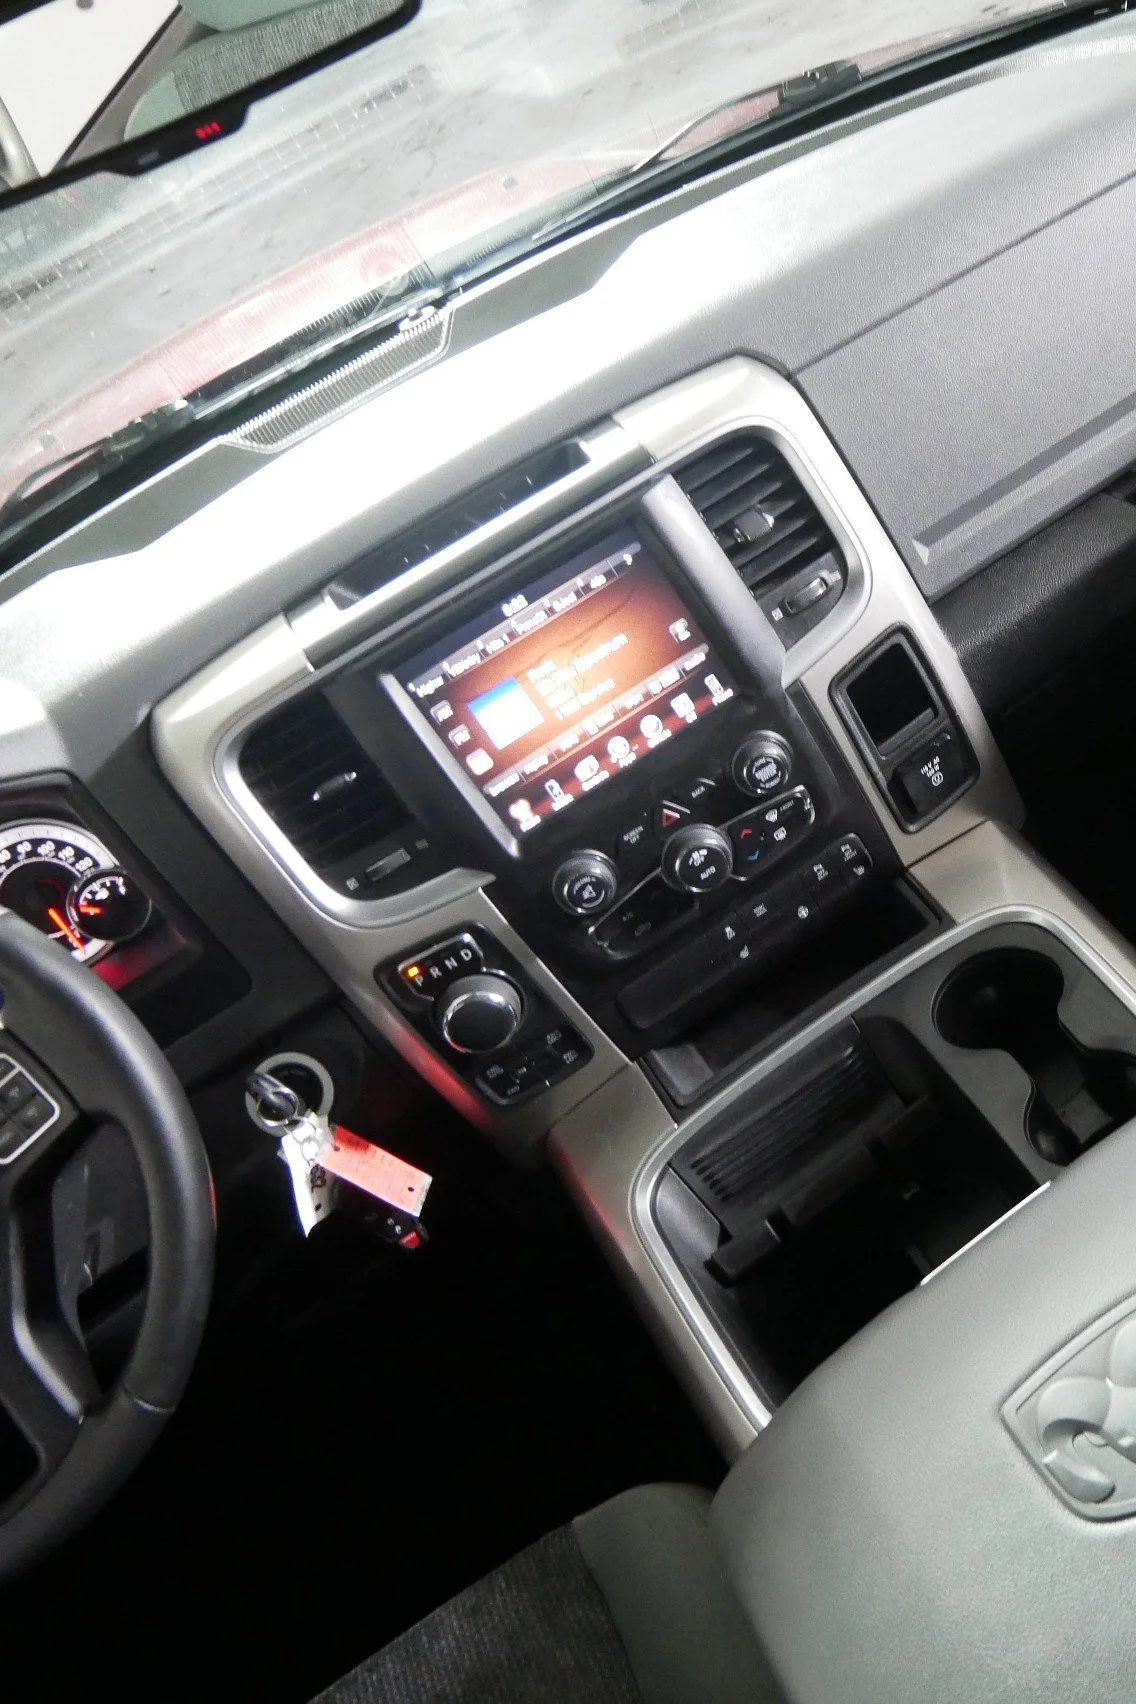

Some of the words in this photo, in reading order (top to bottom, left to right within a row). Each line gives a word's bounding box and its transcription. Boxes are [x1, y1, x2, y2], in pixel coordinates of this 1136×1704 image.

[17, 841, 32, 853] 90
[37, 840, 55, 855] 100
[75, 856, 93, 871] 120
[699, 864, 717, 880] AUTO
[415, 976, 424, 987] P
[429, 966, 443, 979] R
[444, 957, 458, 970] N
[460, 949, 473, 961] D
